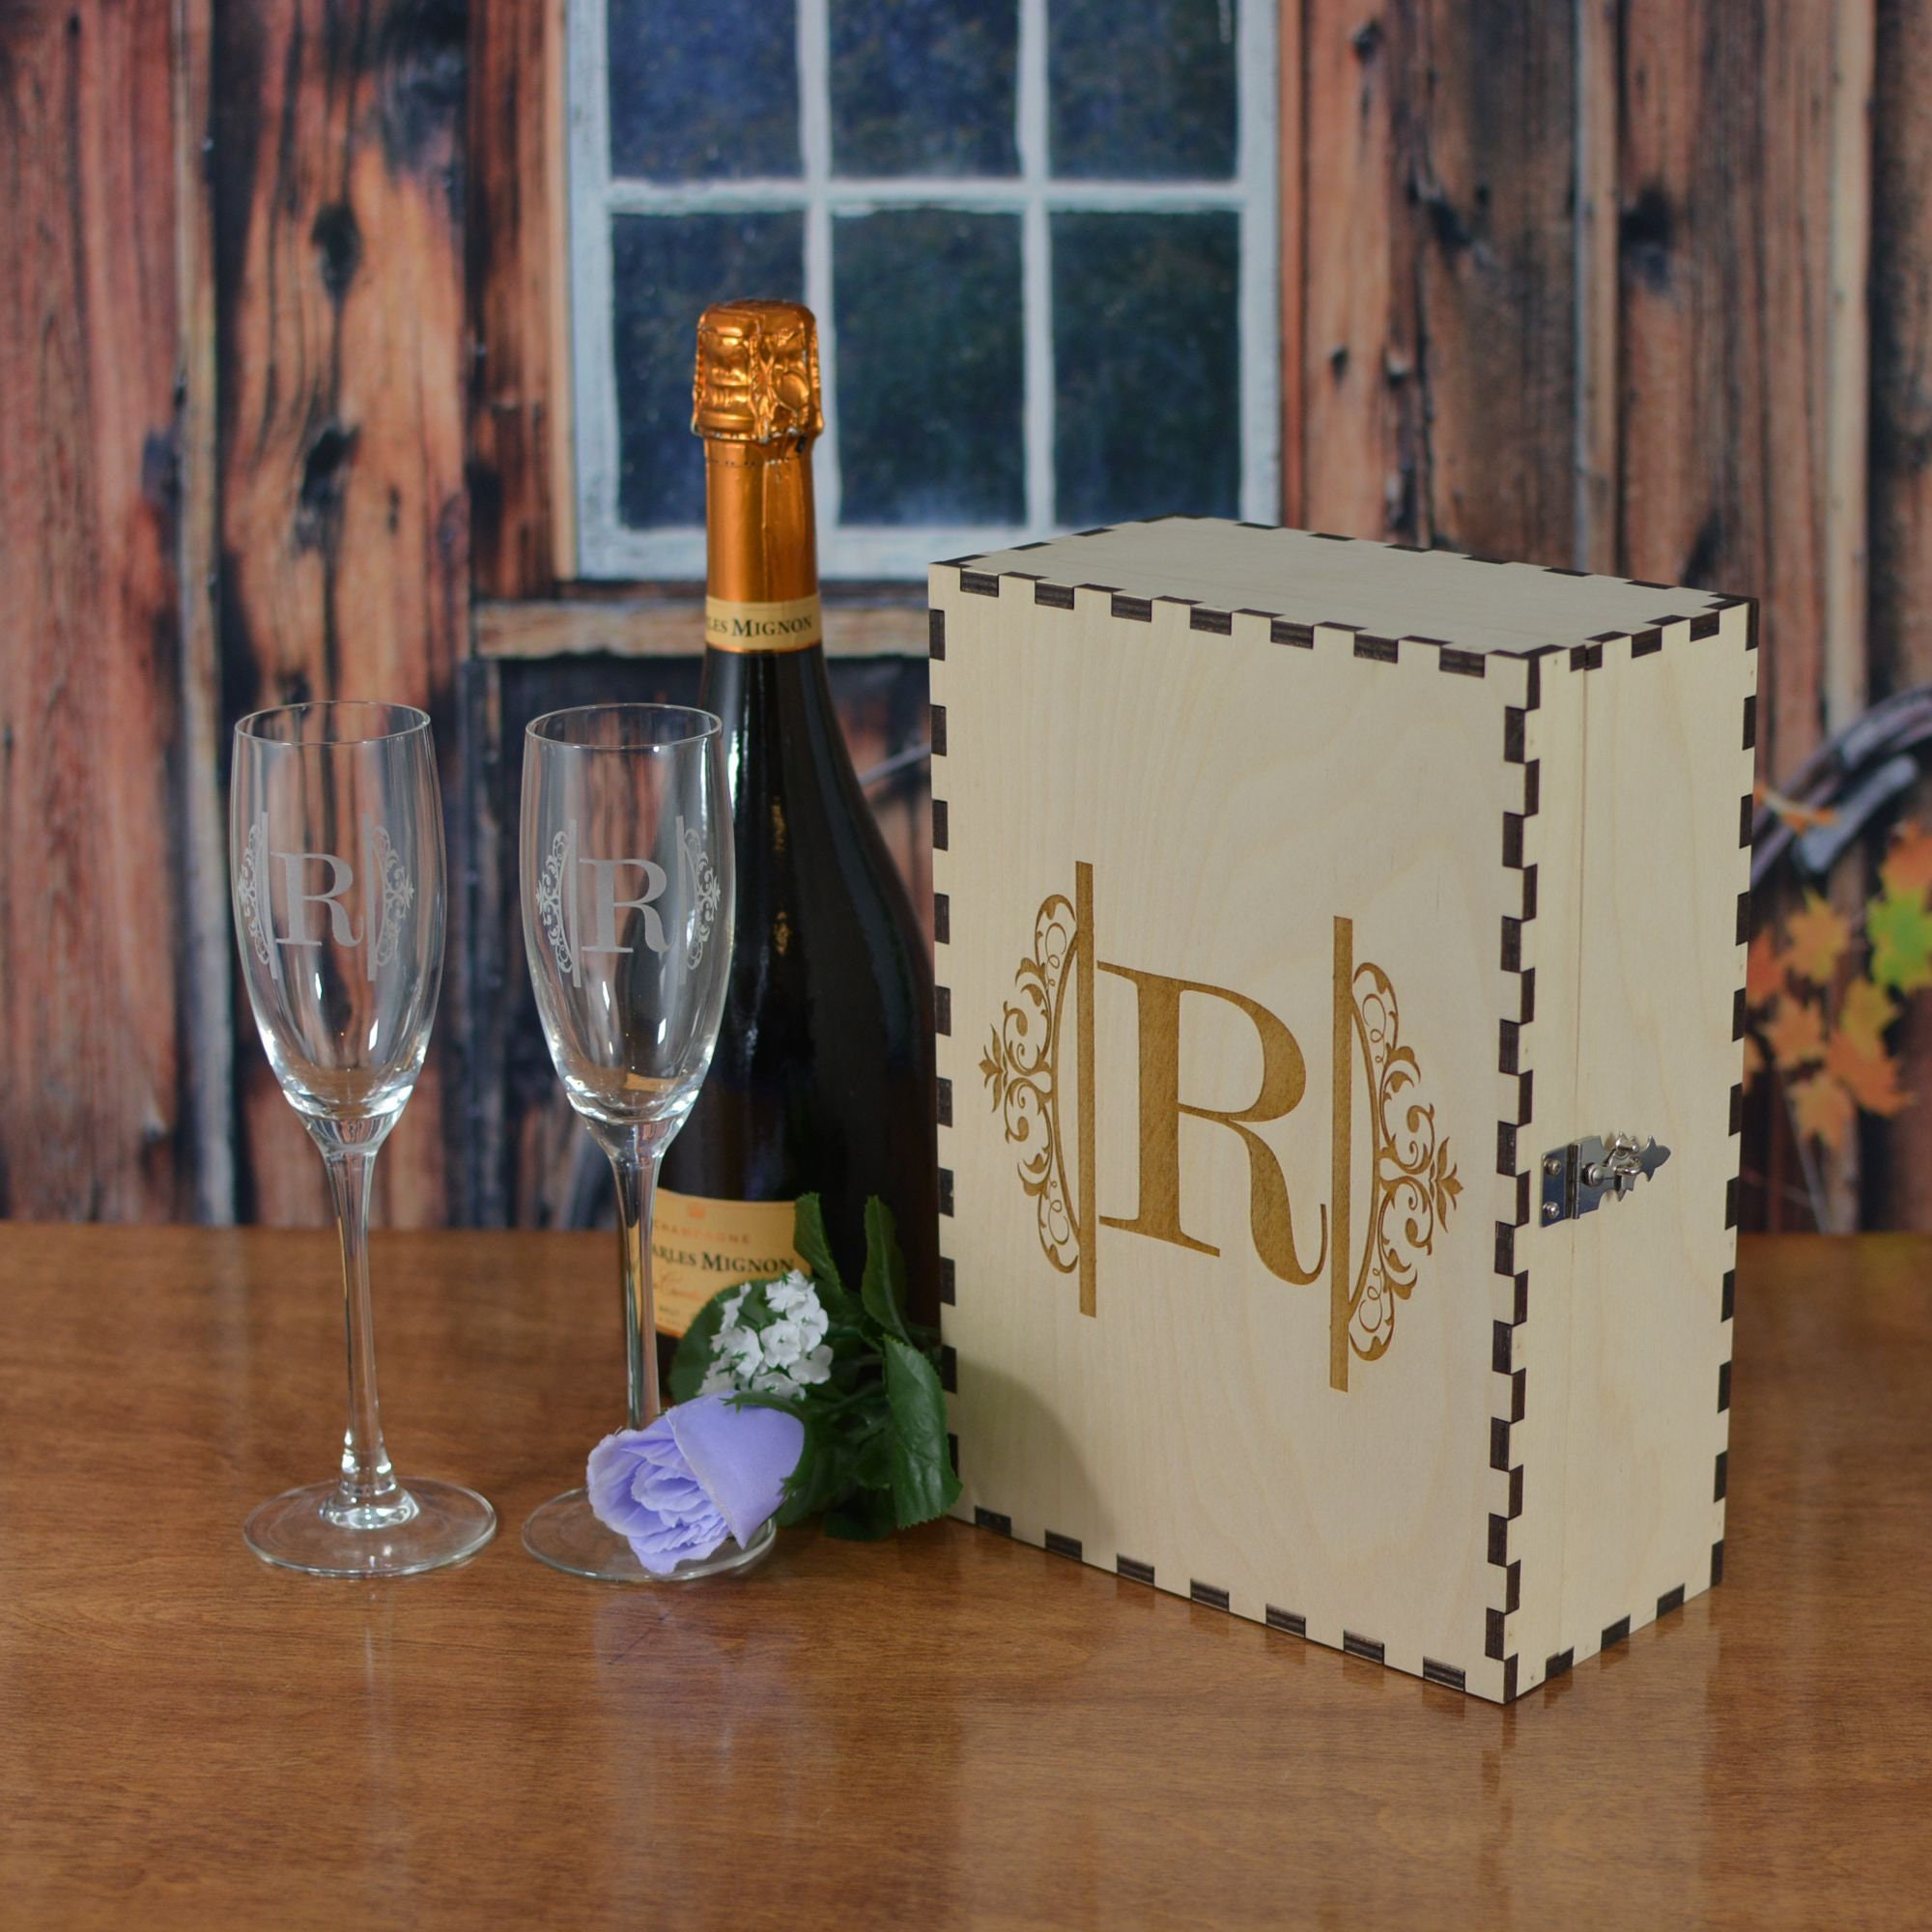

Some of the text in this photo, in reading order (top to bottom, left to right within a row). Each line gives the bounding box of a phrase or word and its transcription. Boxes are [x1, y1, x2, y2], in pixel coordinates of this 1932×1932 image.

[270, 851, 364, 948] R
[580, 858, 675, 953] R
[1097, 960, 1326, 1286] R
